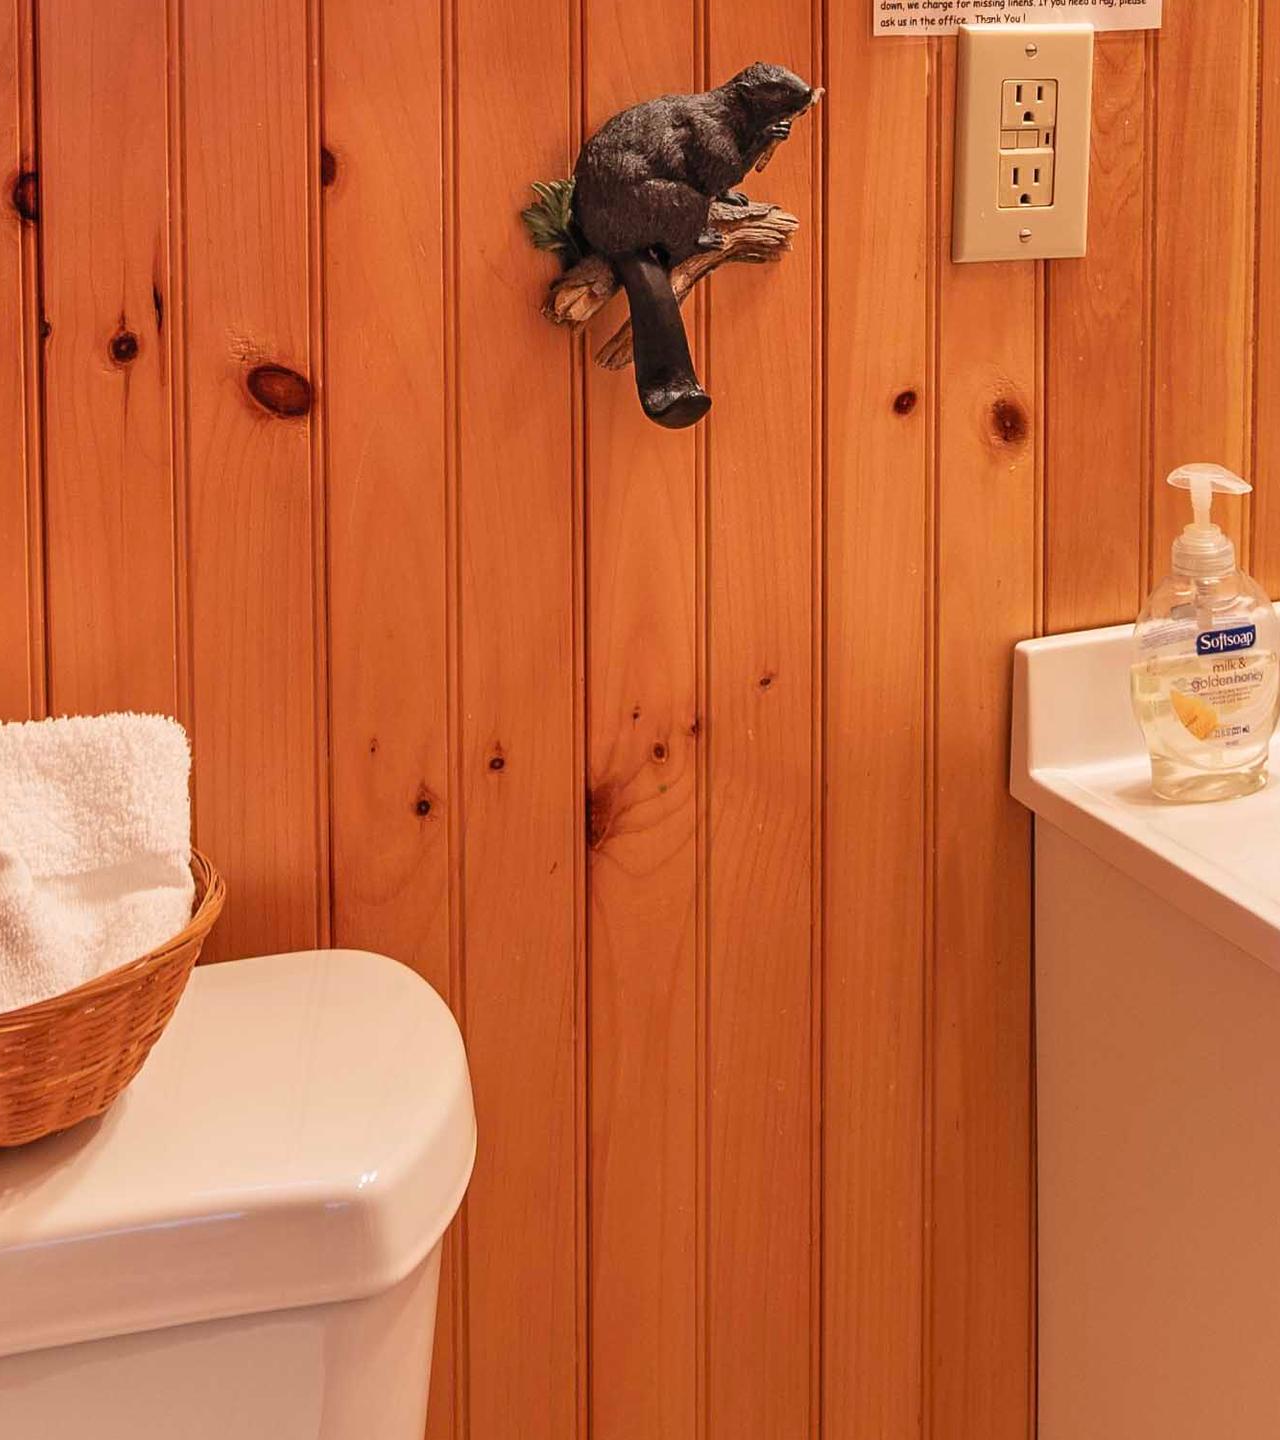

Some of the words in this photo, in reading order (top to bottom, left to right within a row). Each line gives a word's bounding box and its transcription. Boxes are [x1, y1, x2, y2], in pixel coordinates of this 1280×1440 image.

[881, 1, 905, 11] down,
[922, 0, 953, 11] charge
[956, 0, 970, 8] for
[1051, 0, 1066, 8] you
[881, 19, 895, 27] ask
[910, 17, 917, 25] in
[920, 16, 935, 27] the
[975, 15, 1001, 24] Thank
[1004, 13, 1020, 23] You
[1200, 631, 1253, 650] Softsoap
[1213, 660, 1237, 673] milk
[1239, 657, 1247, 668] &
